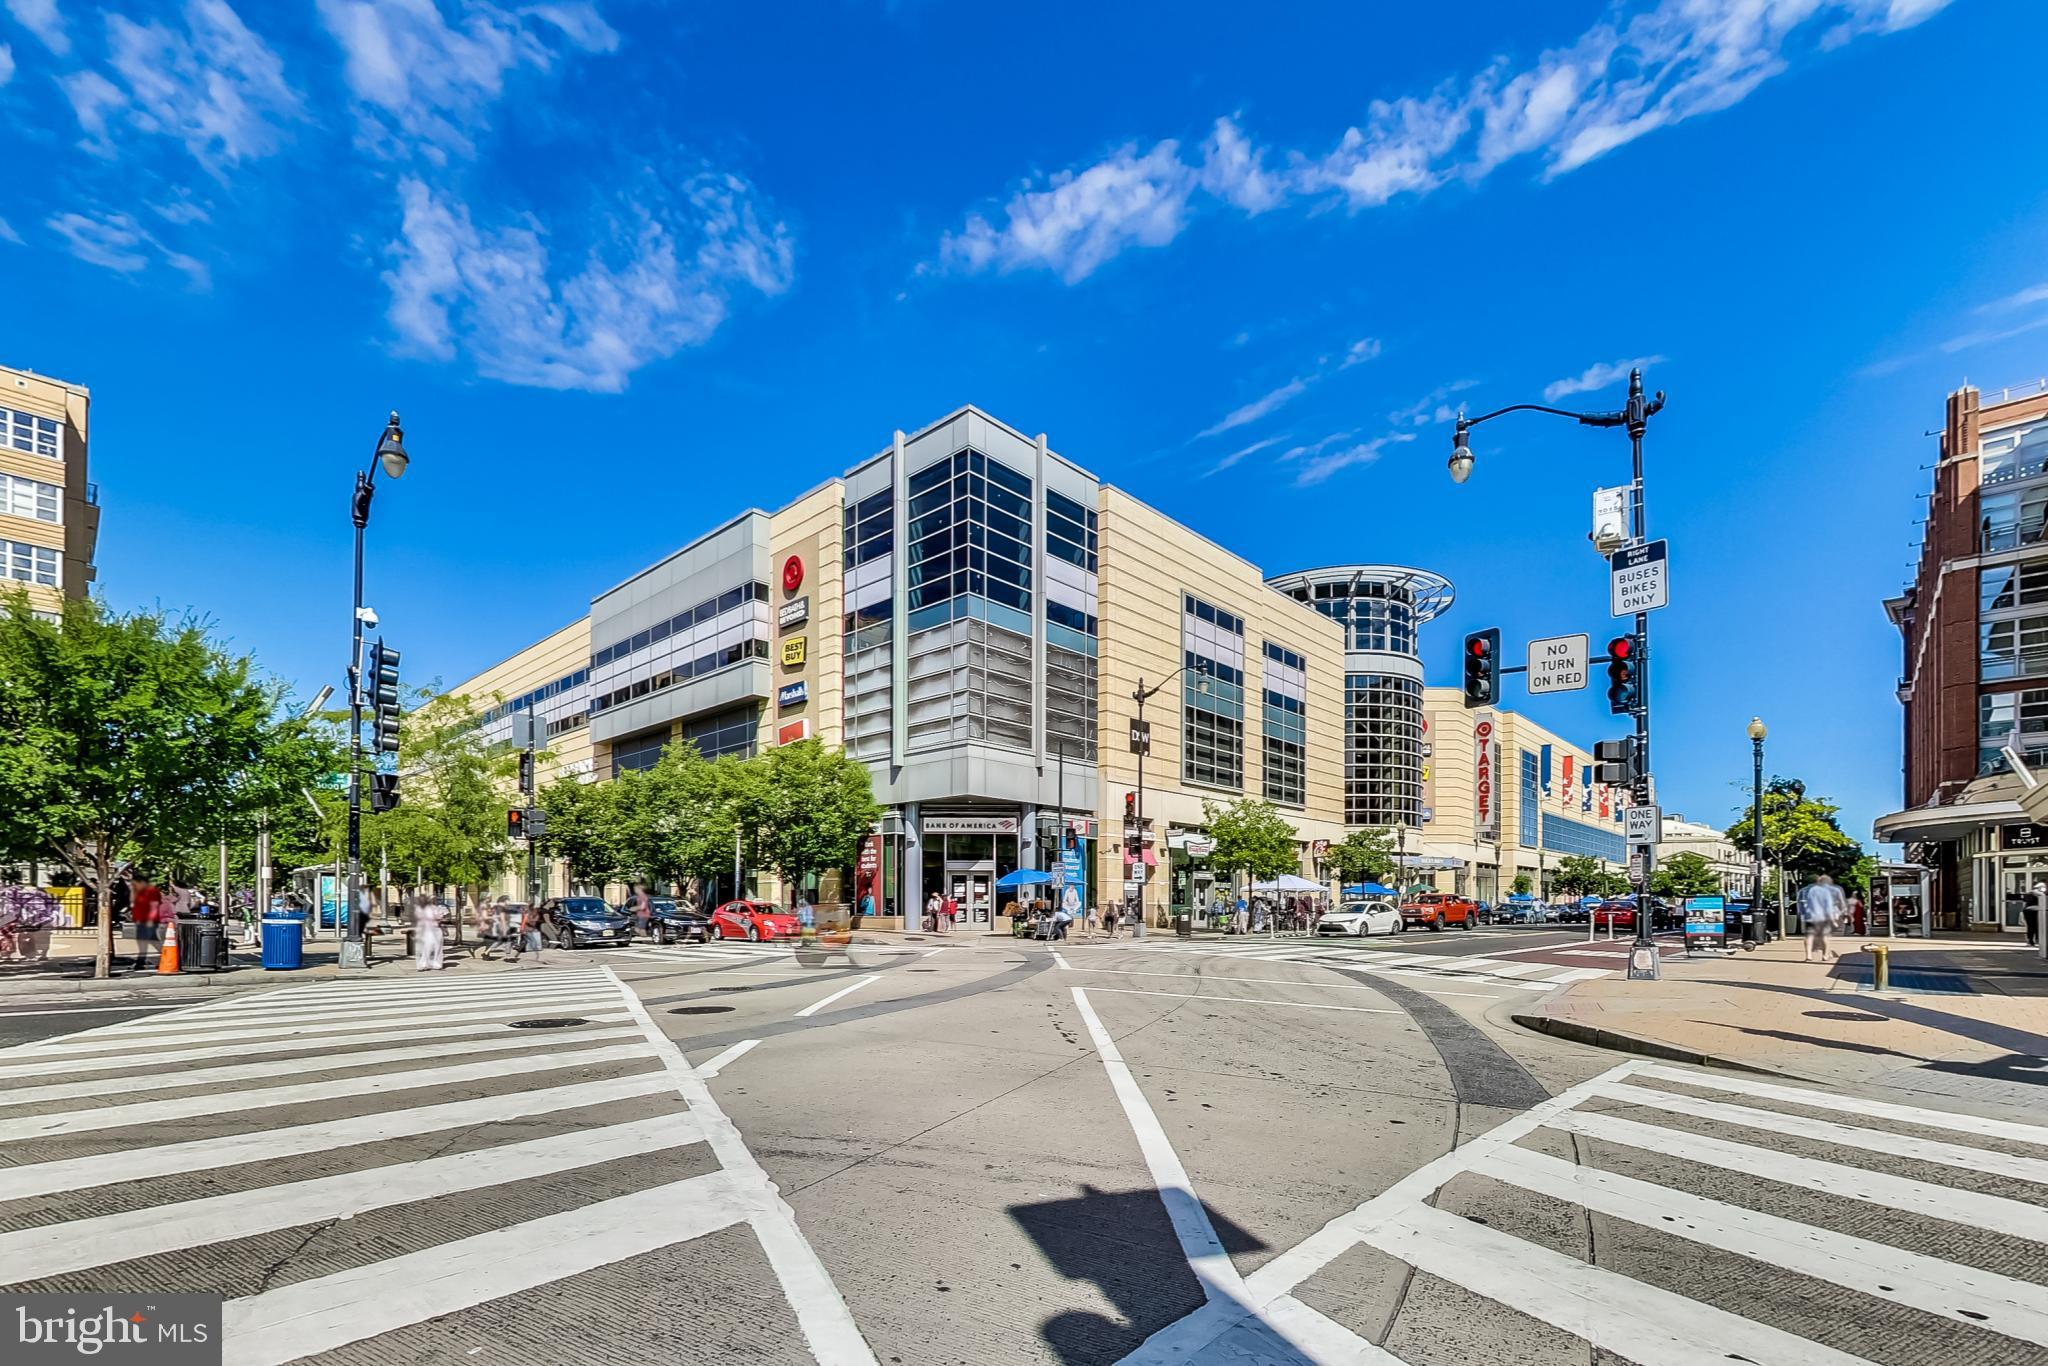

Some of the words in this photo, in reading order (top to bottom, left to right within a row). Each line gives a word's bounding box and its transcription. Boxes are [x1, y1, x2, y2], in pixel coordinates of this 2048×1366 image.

[1627, 546, 1649, 557] RIGHT
[1628, 555, 1648, 565] LANE
[1619, 567, 1659, 584] BUSES
[1621, 580, 1657, 596] BIKES
[1623, 593, 1655, 608] ONLY
[785, 642, 803, 652] BEST
[1547, 644, 1568, 657] NO
[785, 652, 801, 661] BUY
[1541, 658, 1575, 672] TURN
[1533, 674, 1551, 687] ON
[1557, 672, 1582, 684] RED
[779, 686, 805, 701] Marshalls
[1478, 739, 1490, 822] TARGET
[1630, 809, 1652, 819] ONE
[1629, 820, 1653, 830] WAY
